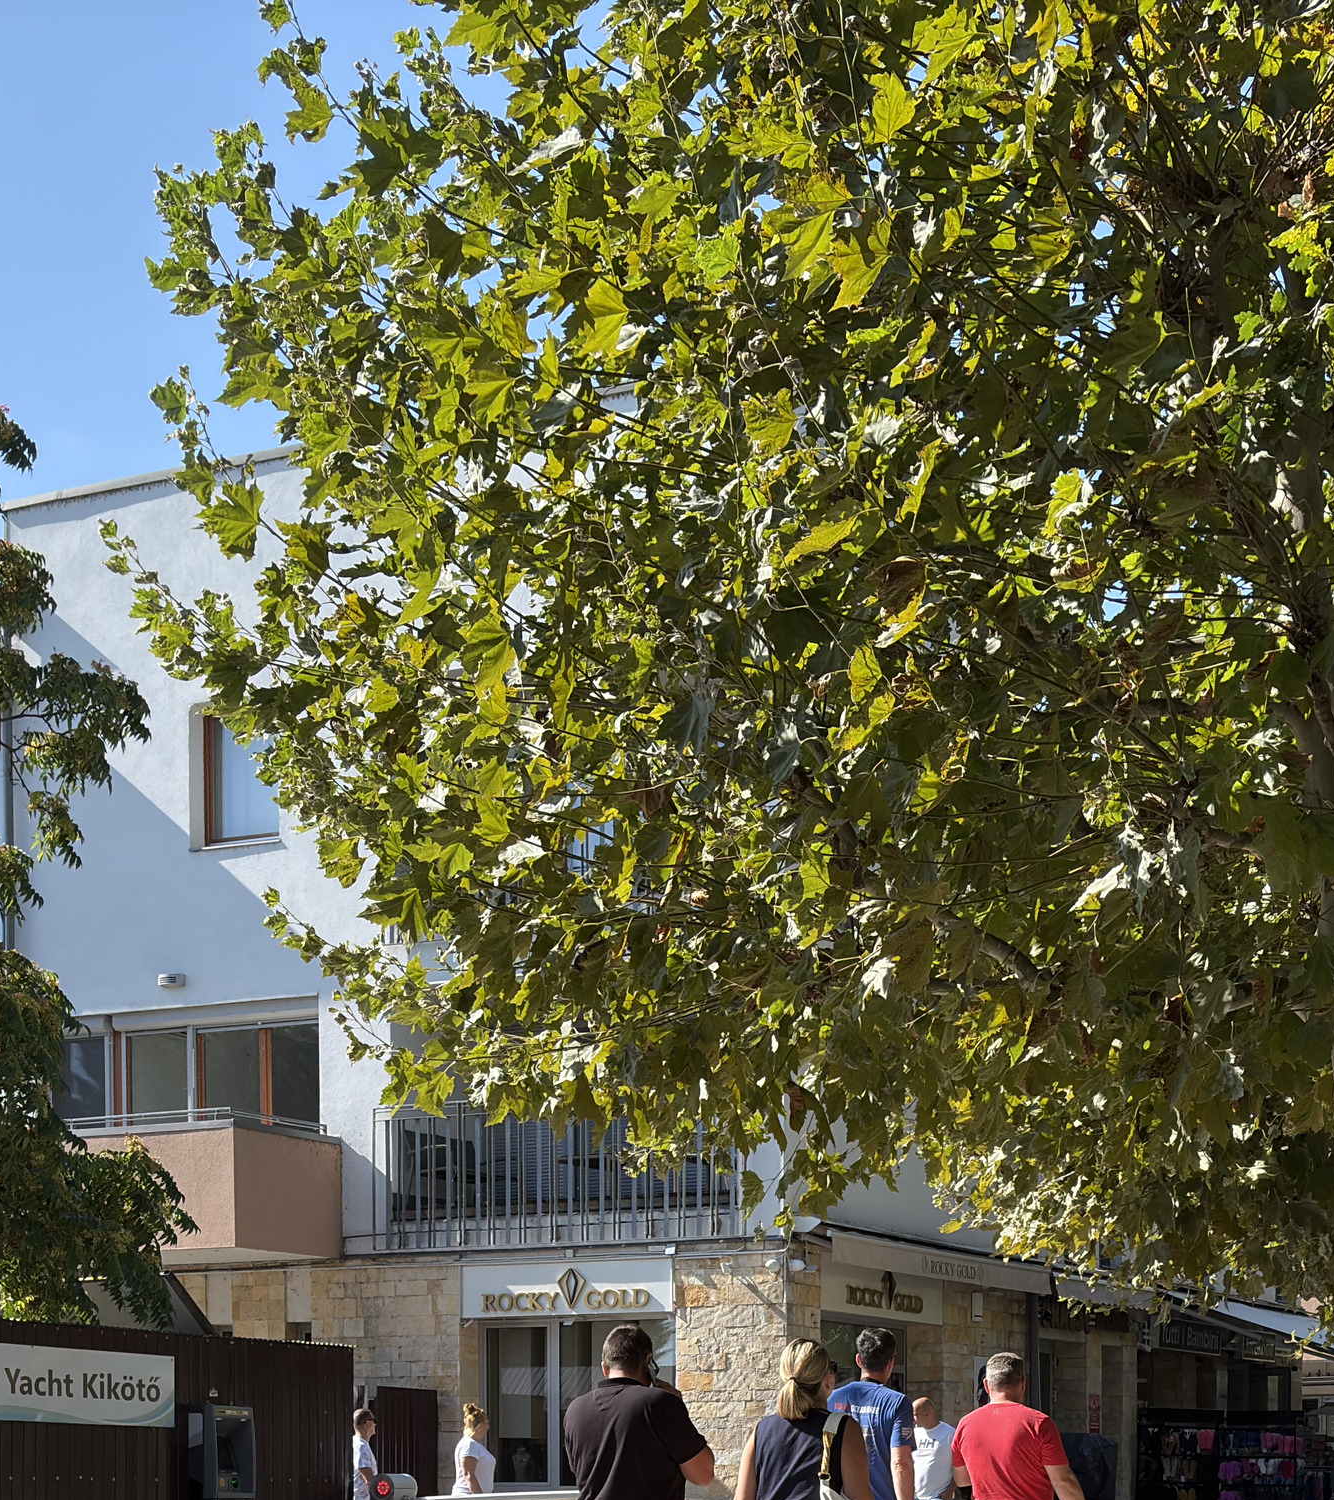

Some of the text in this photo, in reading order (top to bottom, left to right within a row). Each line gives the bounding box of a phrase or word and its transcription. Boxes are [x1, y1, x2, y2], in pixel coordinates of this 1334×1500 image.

[930, 1260, 977, 1280] ROCKY GOLD
[481, 1288, 650, 1313] ROCKY GOLD
[845, 1284, 924, 1315] ROCKY GOLD
[1186, 1326, 1219, 1351] Bambini
[4, 1367, 74, 1398] Yacht
[82, 1373, 161, 1402] Kikötő
